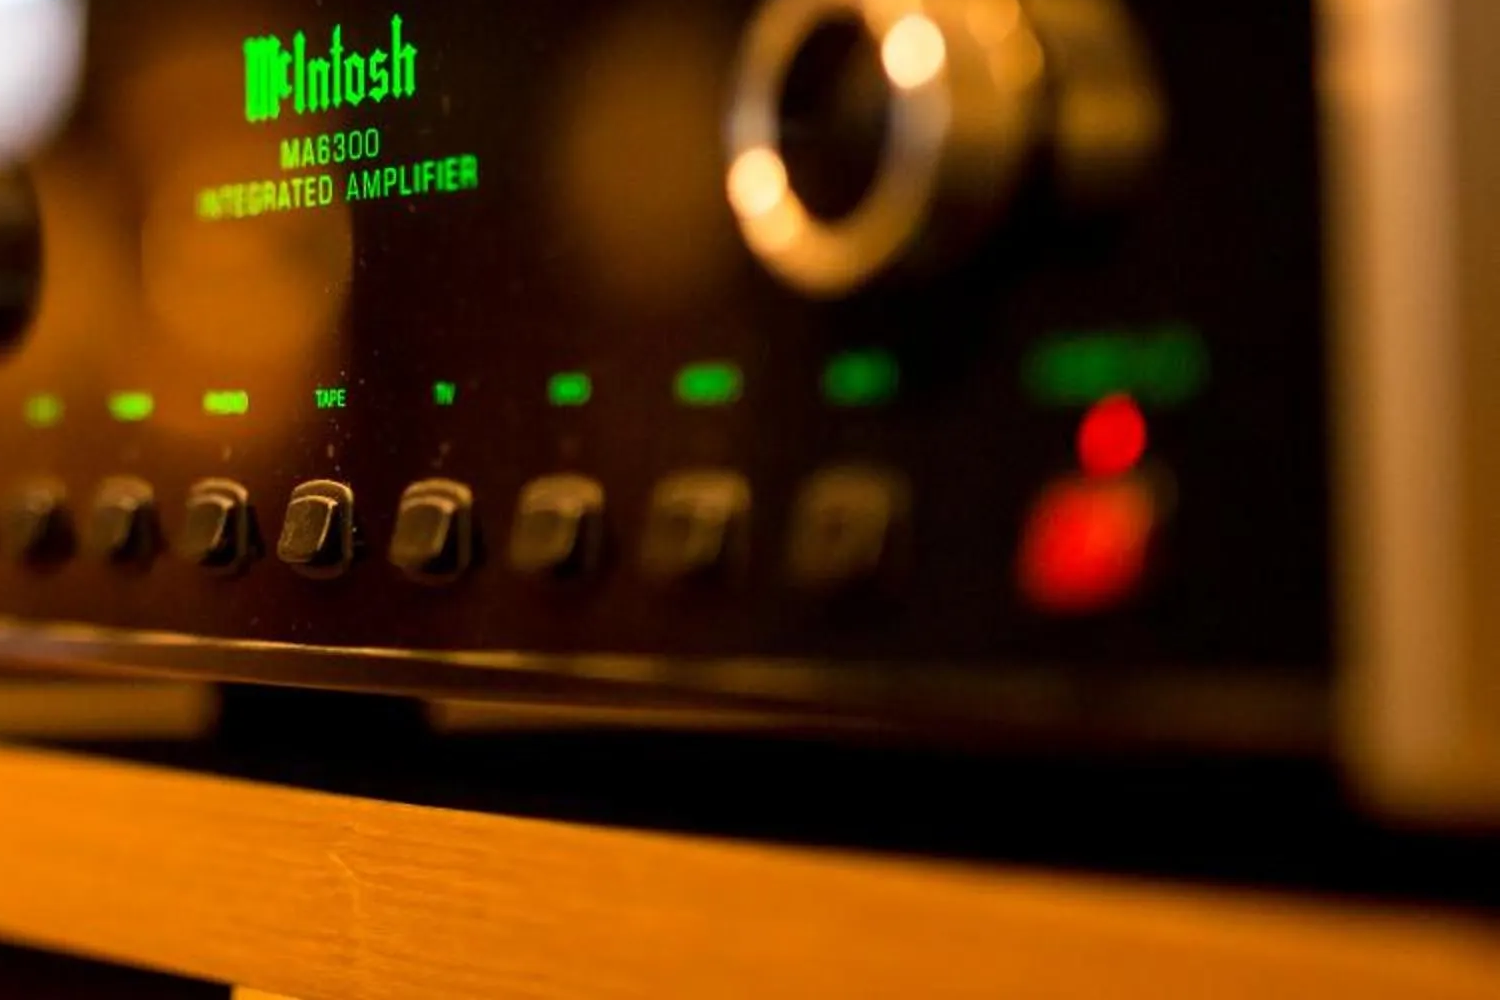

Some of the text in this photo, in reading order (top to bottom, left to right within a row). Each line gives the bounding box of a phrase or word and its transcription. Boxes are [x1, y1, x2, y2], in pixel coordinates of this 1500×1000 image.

[243, 13, 417, 122] McIntosh
[280, 128, 380, 170] MA6300
[346, 154, 478, 200] AMPLIFIER
[315, 389, 346, 408] TAPE
